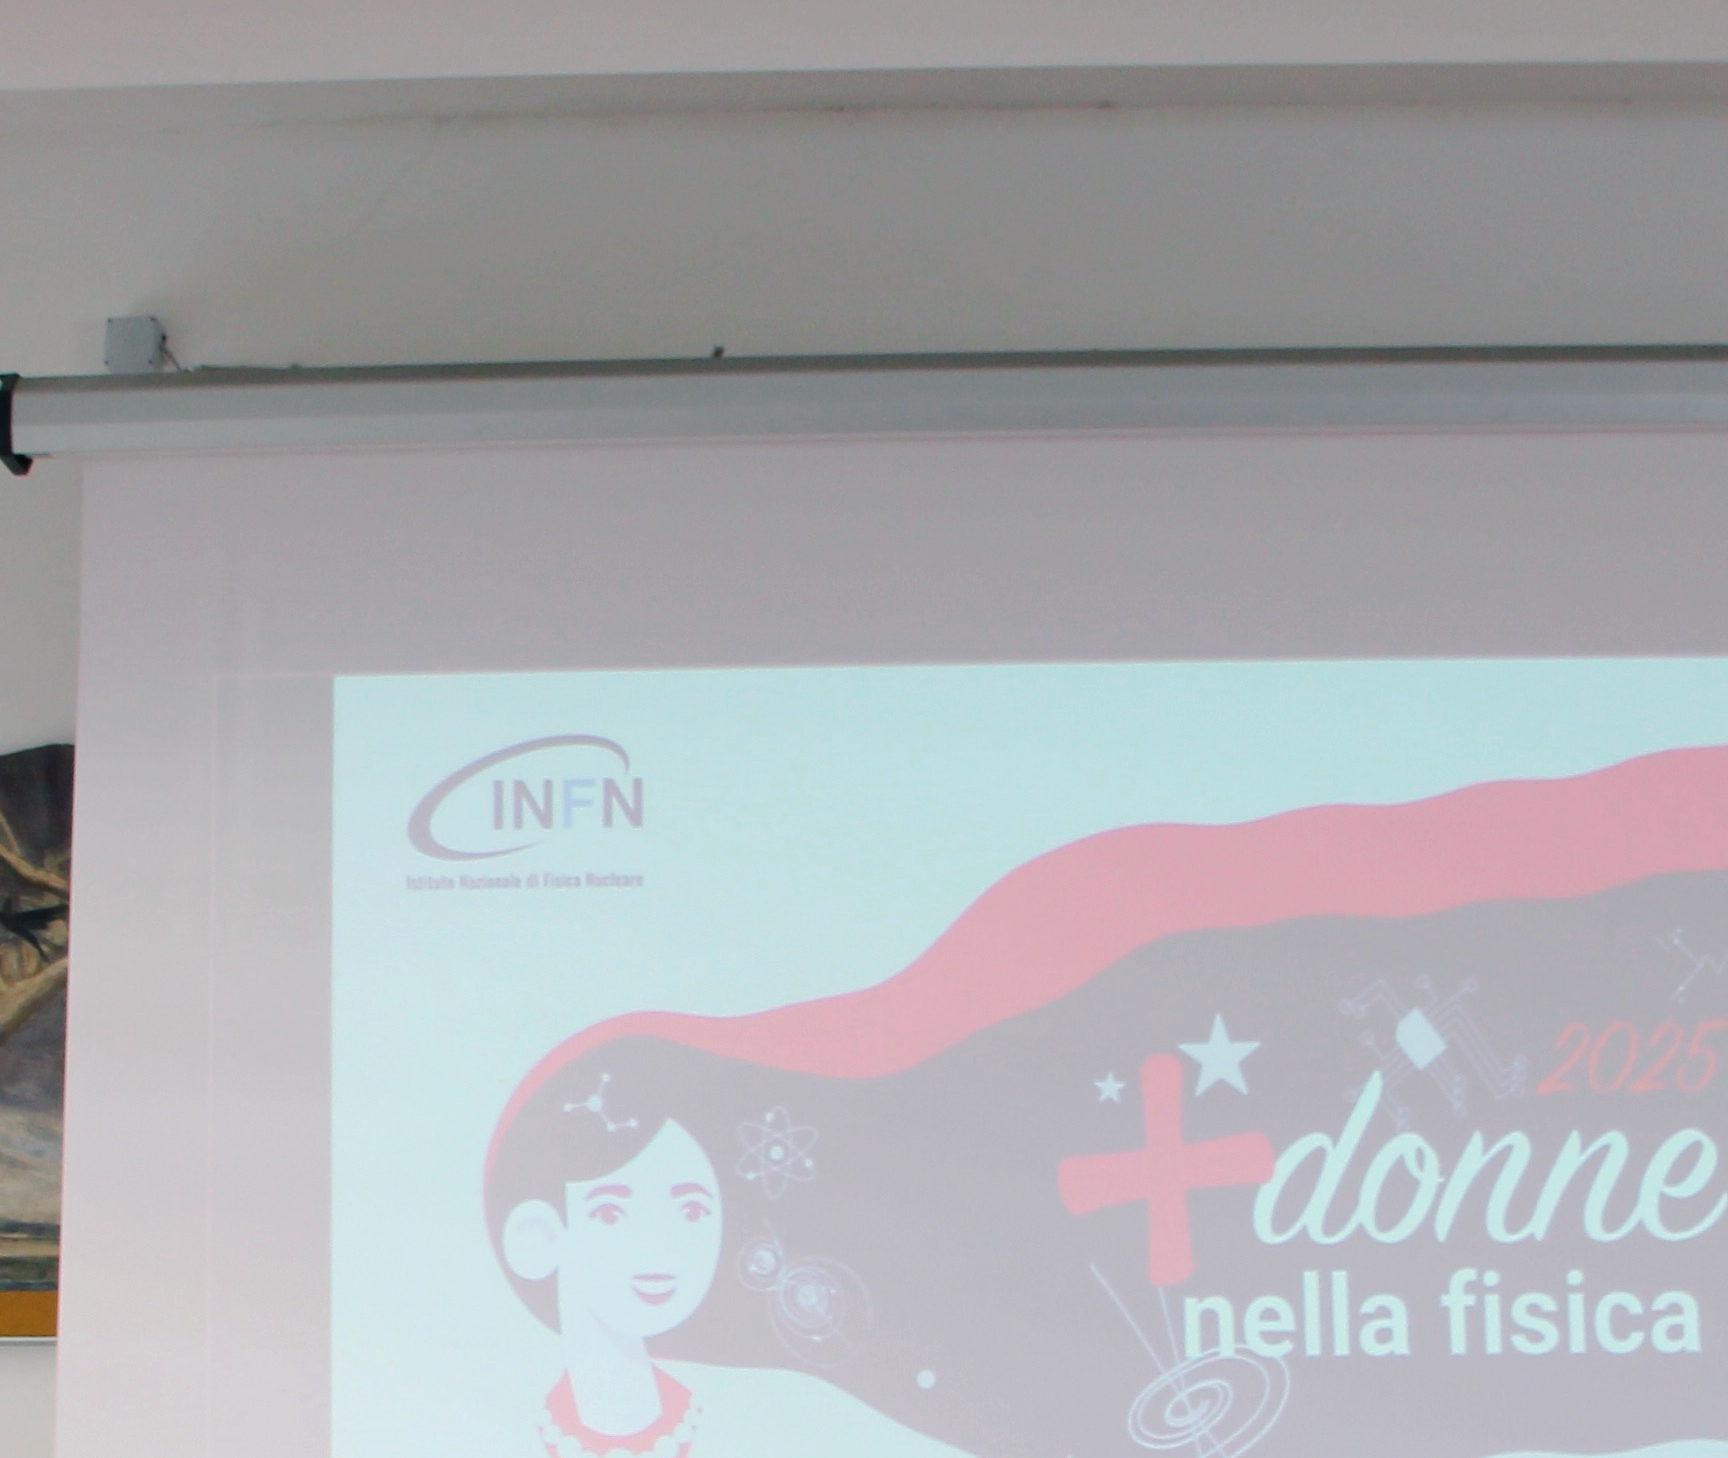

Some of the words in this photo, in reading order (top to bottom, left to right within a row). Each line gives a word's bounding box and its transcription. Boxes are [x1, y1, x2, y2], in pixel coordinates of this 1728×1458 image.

[493, 777, 643, 830] INFN
[1182, 1269, 1410, 1358] nella
[1440, 1269, 1702, 1356] fisica
